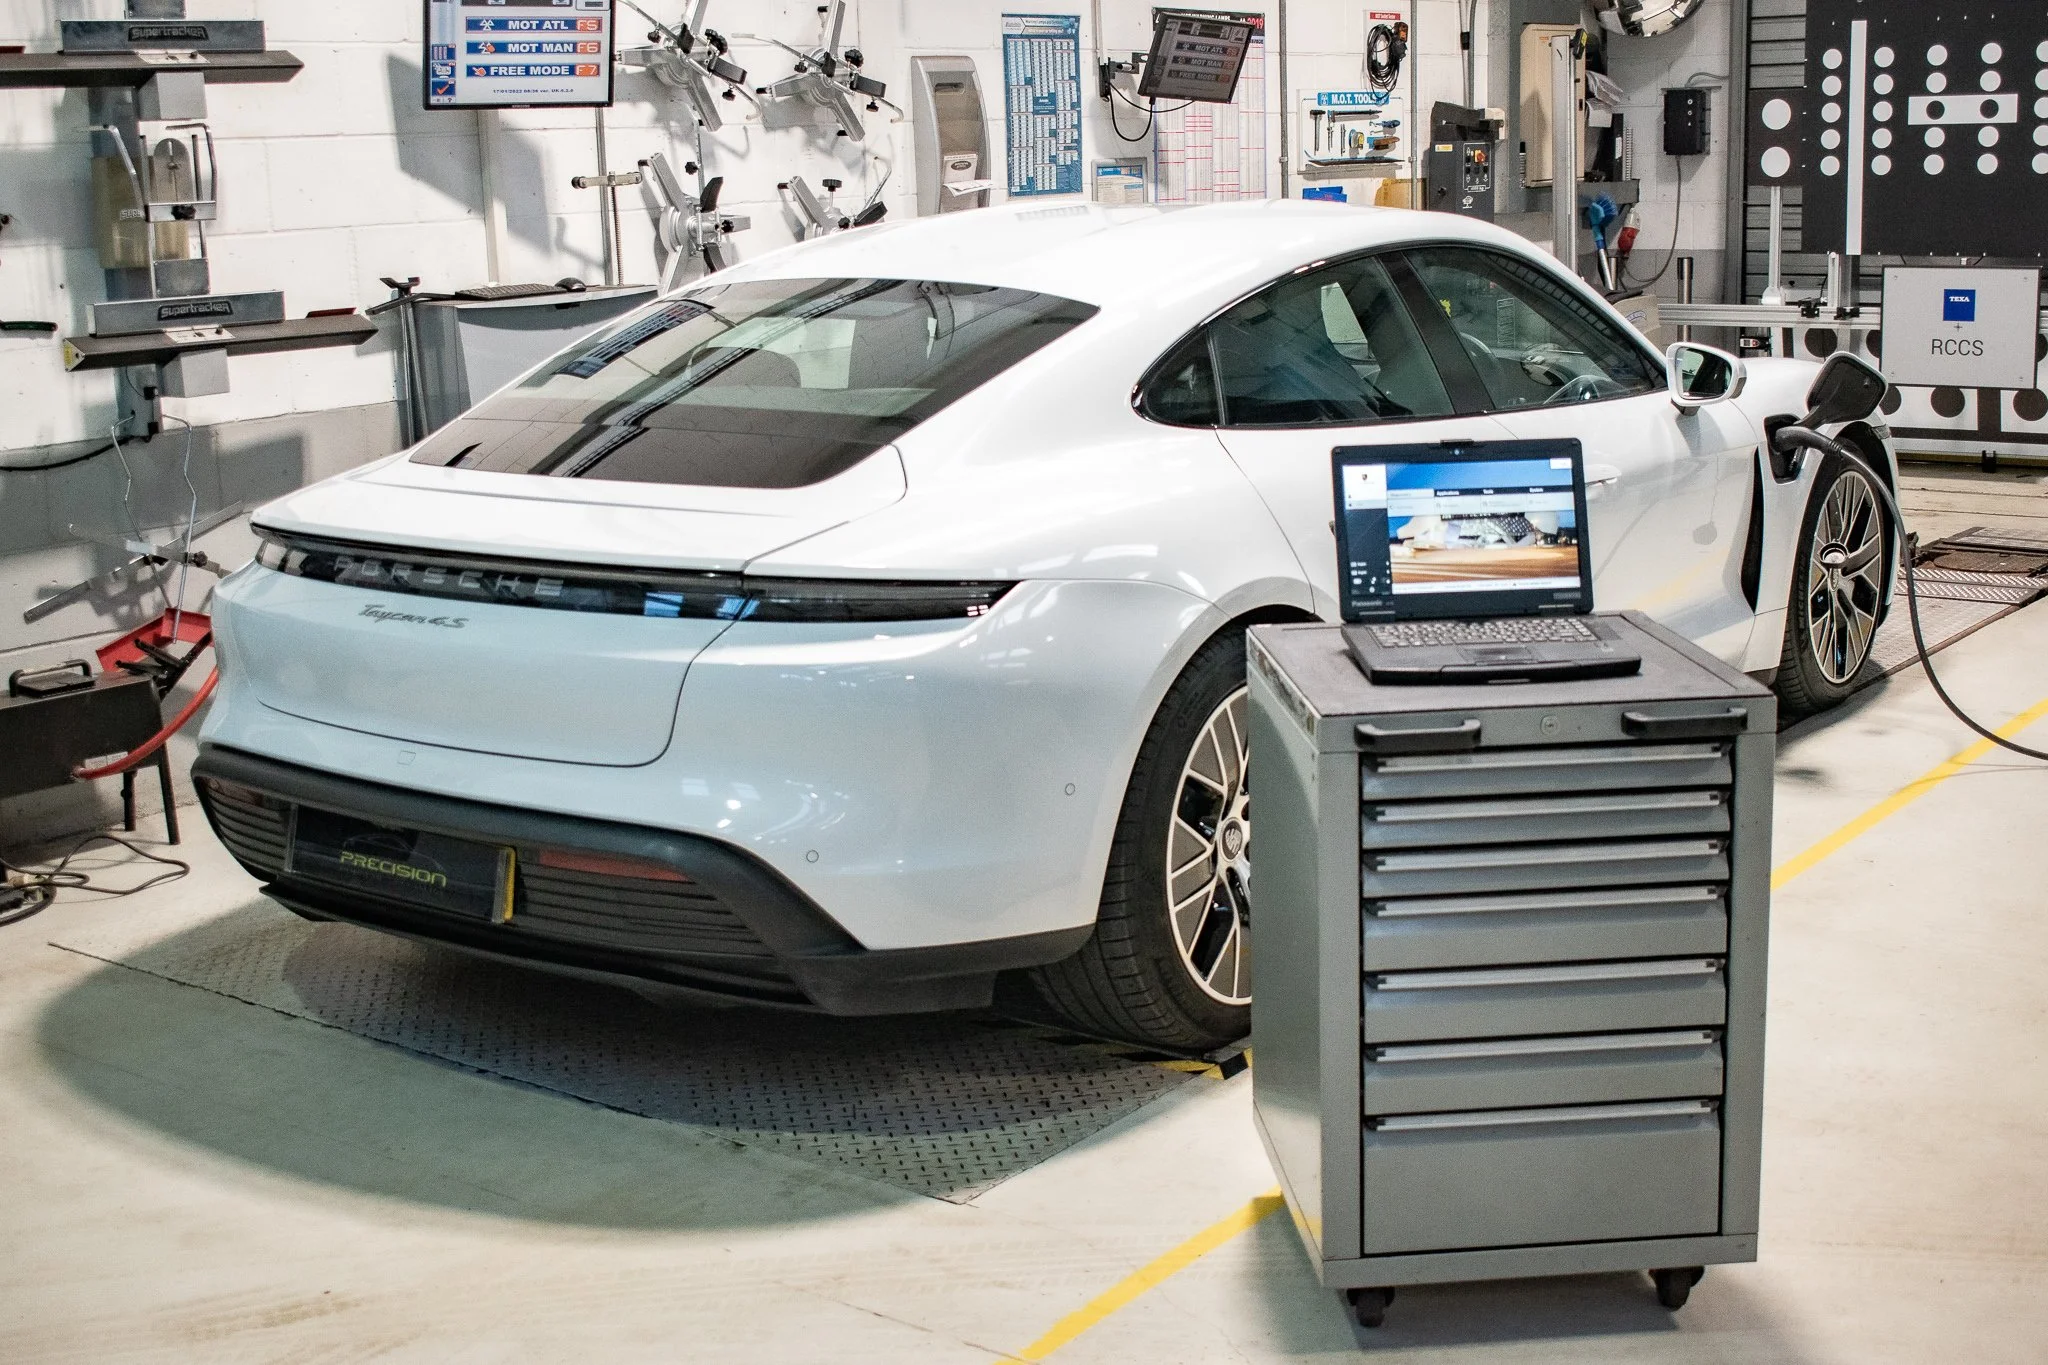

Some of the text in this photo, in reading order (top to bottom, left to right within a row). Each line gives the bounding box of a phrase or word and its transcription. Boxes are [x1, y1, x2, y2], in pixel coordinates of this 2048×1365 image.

[508, 20, 539, 30] MOT
[542, 20, 568, 30] ATL
[507, 42, 598, 53] MOT MAN F6
[1195, 45, 1210, 53] MOT
[1211, 46, 1224, 54] ATL
[1190, 58, 1206, 66] MOT
[1206, 59, 1222, 68] MAN
[490, 66, 526, 76] FREE
[529, 65, 570, 75] MODE
[1331, 94, 1377, 104] M.O.T. TOOLS
[1931, 338, 1984, 357] RCCS
[334, 556, 564, 596] PORSCHE
[358, 604, 427, 624] Taycan
[340, 851, 447, 888] PRECISION
